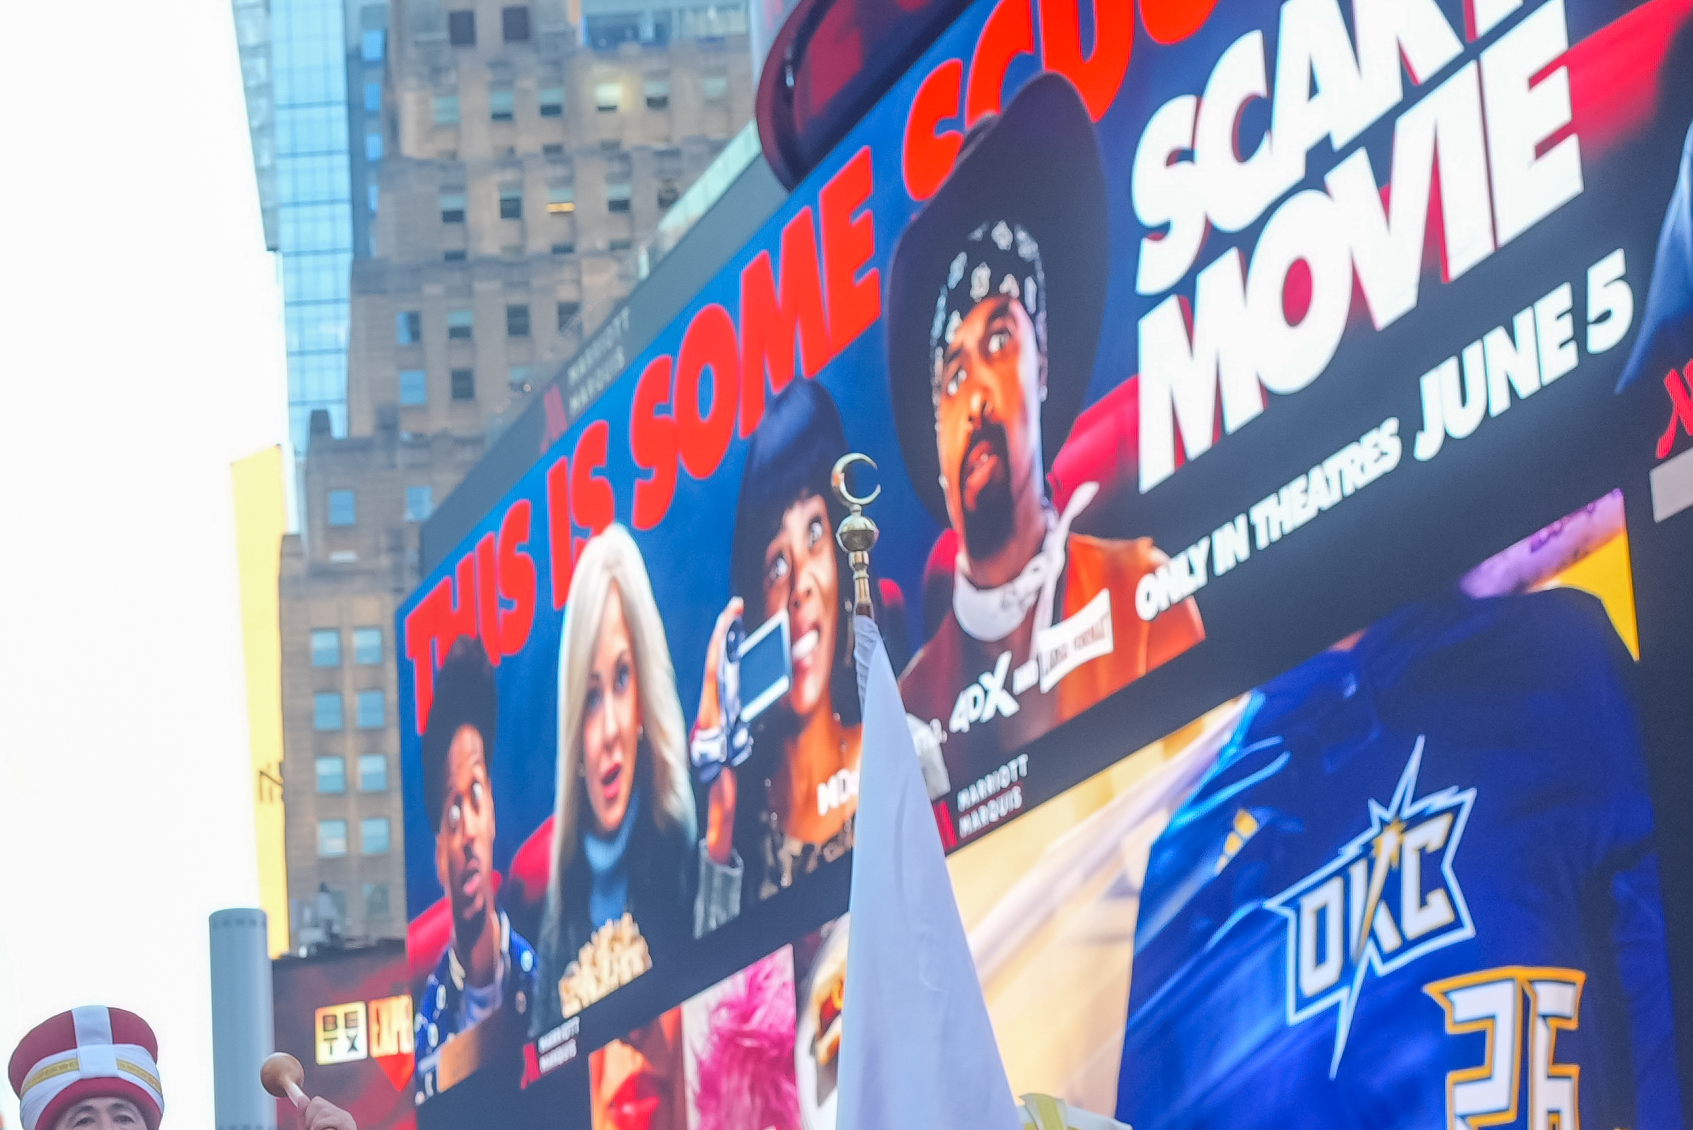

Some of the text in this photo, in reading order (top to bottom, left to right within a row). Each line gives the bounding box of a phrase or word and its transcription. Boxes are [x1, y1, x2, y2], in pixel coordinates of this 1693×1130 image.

[1132, 0, 1523, 295] SCAR
[1138, 0, 1584, 494] MOVIE
[406, 146, 881, 735] THIS IS SOME
[1135, 537, 1210, 622] ONLY
[1212, 514, 1250, 576] IN
[1250, 416, 1403, 549] THEATRES
[1414, 282, 1579, 461] JUNE
[1586, 248, 1634, 354] 5
[949, 650, 1020, 733] 4DX
[957, 753, 1029, 812] MARRIOTT
[958, 785, 1023, 838] MARQUIS
[1296, 808, 1456, 1000] OKC
